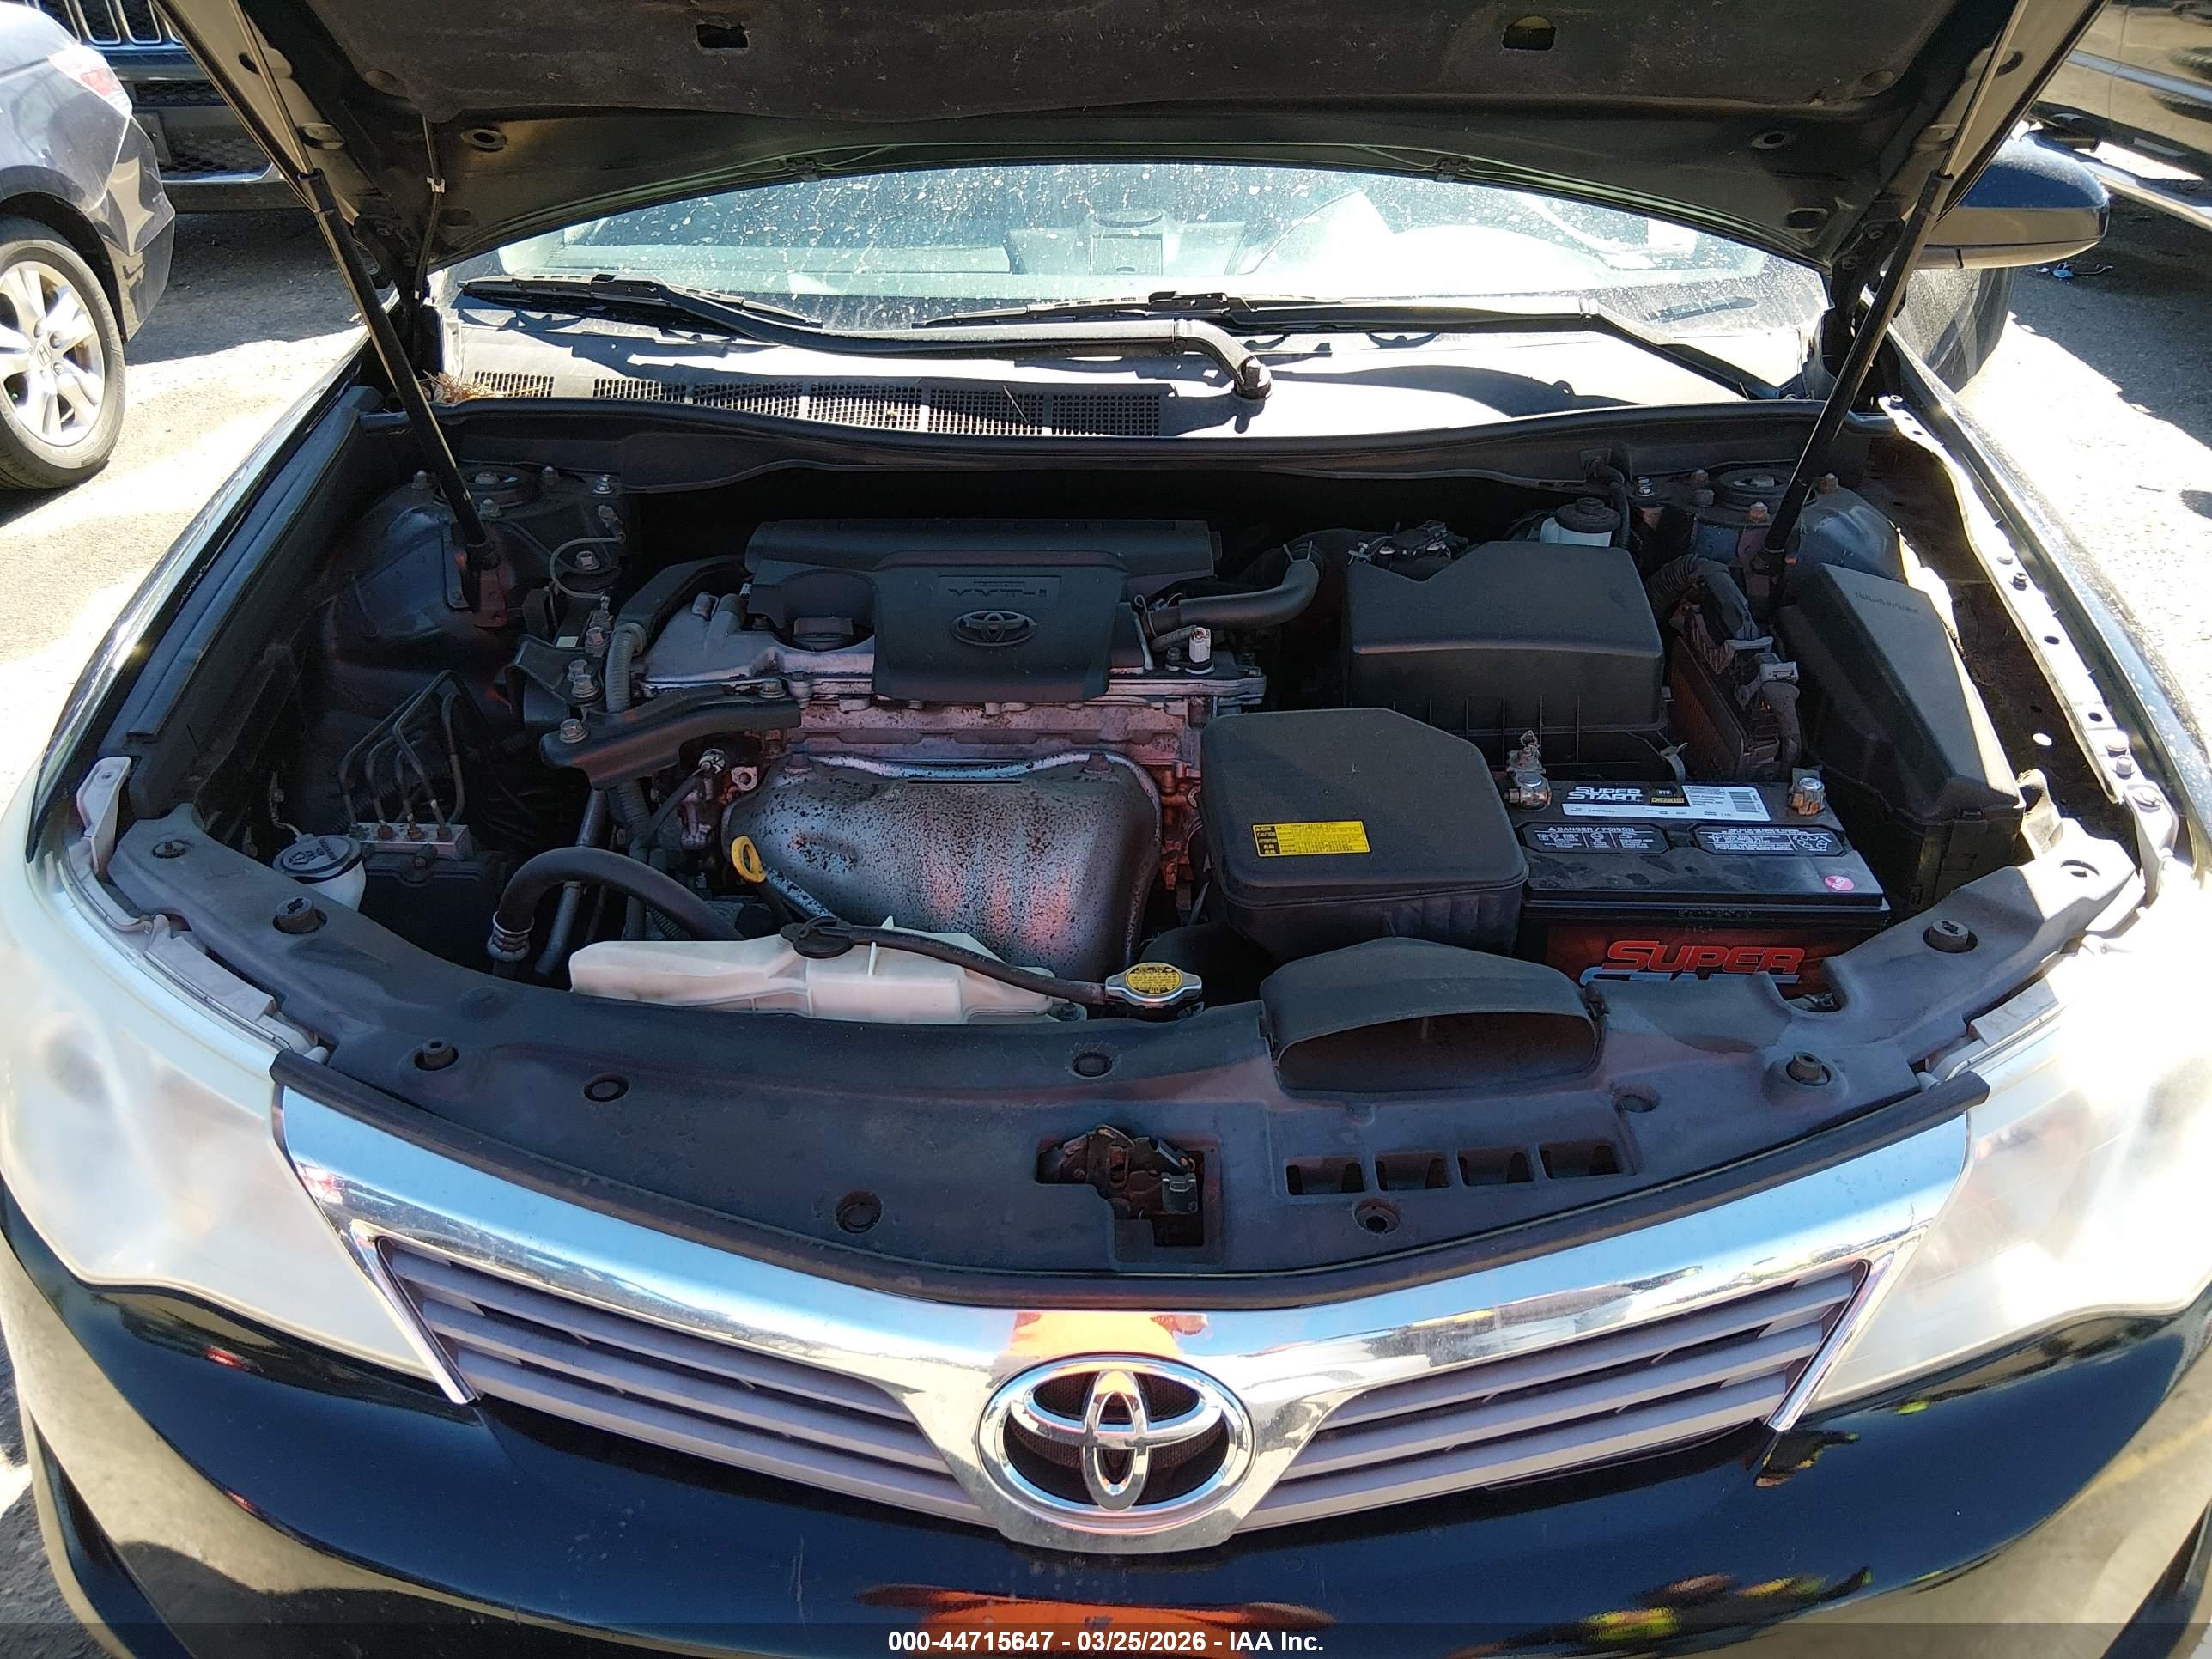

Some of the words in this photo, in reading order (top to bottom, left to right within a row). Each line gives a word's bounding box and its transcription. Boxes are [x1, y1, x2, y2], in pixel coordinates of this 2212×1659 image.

[1575, 786, 1641, 795] SUPER
[1567, 791, 1643, 801] START
[1601, 940, 1805, 974] SUPER
